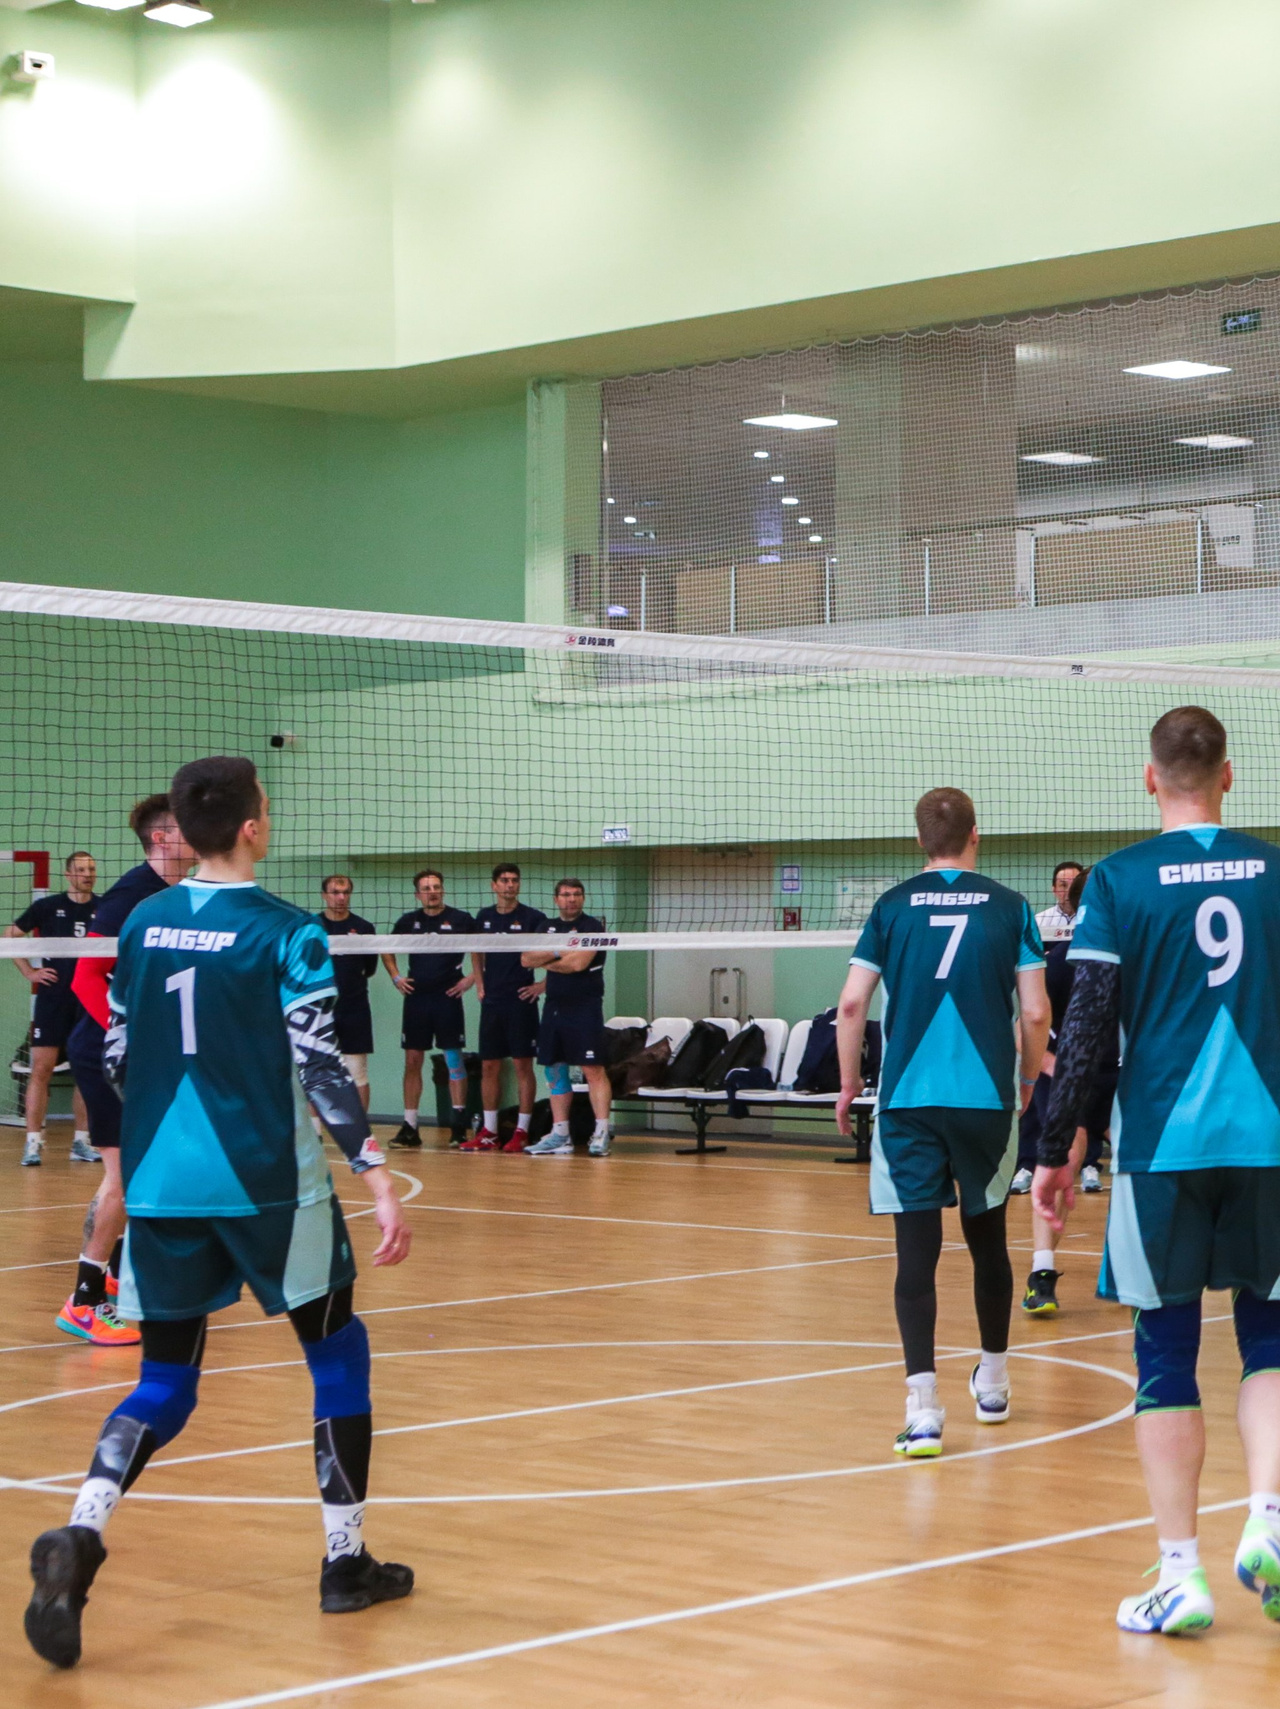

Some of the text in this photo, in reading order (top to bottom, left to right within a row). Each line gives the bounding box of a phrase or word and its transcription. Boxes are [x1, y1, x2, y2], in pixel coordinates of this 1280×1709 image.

[1158, 859, 1266, 885] СИБУР
[910, 892, 990, 906] СИБУР
[74, 921, 86, 938] 5
[143, 926, 238, 952] СИБУР
[1194, 895, 1244, 987] 9
[929, 914, 969, 979] 7
[165, 966, 198, 1055] 1
[33, 1027, 42, 1039] 5
